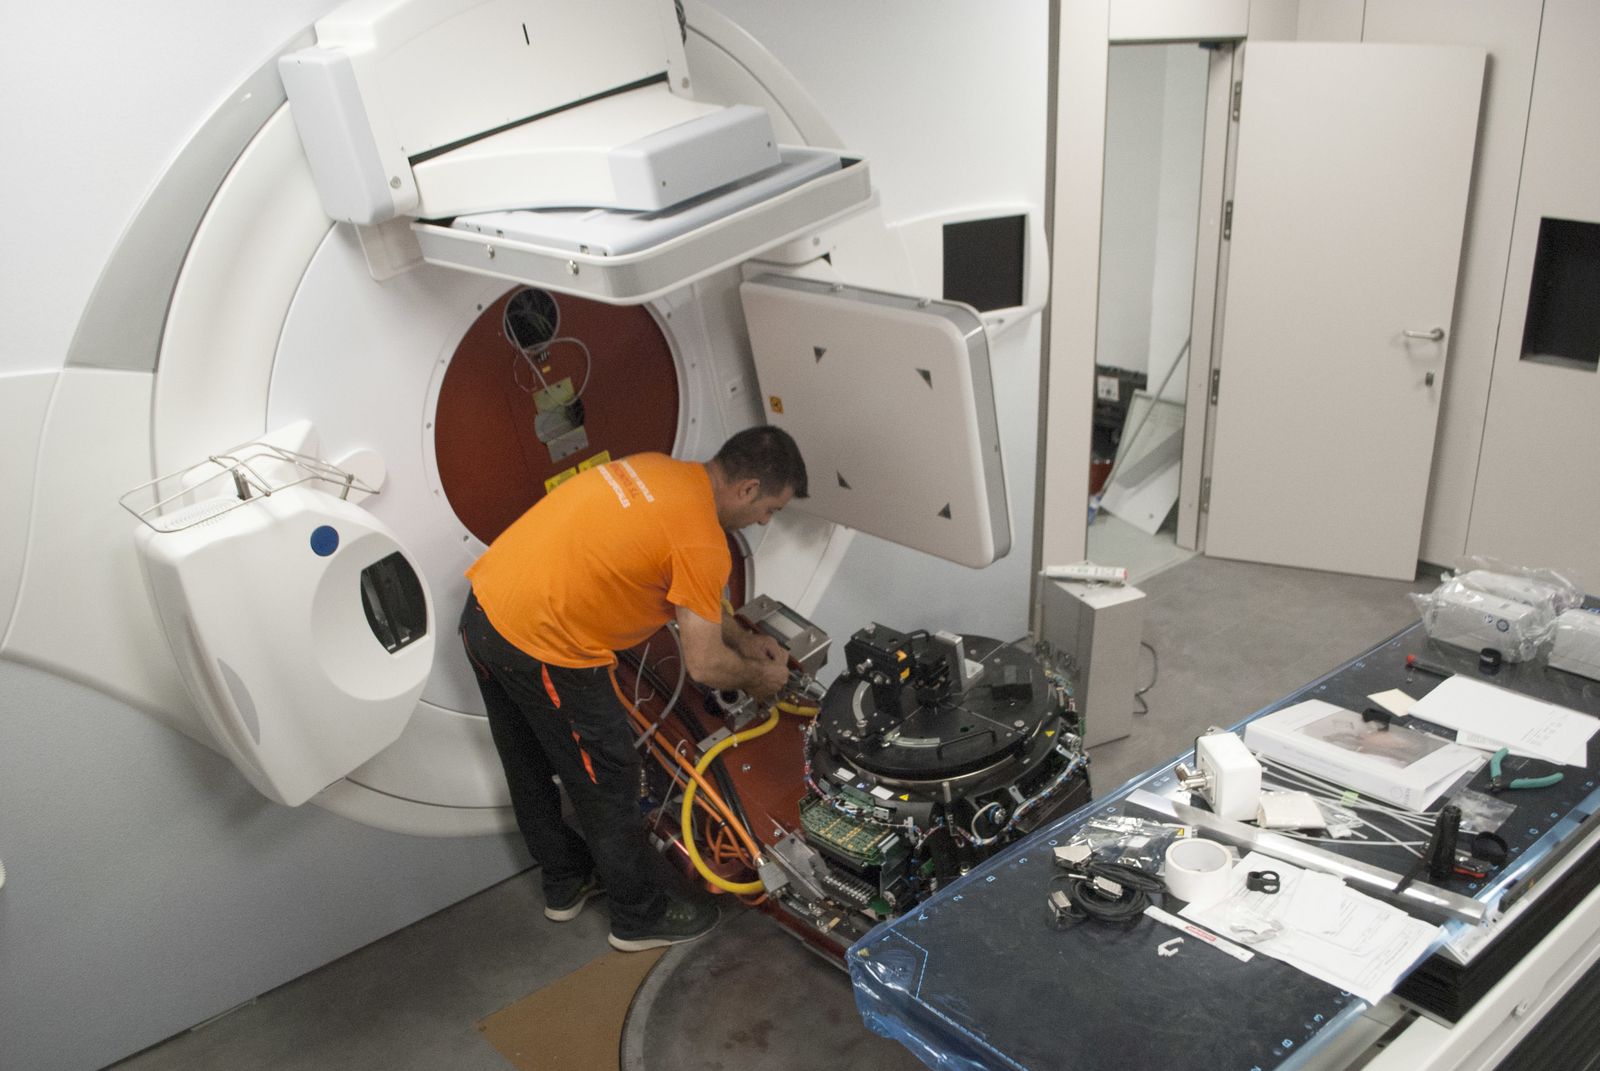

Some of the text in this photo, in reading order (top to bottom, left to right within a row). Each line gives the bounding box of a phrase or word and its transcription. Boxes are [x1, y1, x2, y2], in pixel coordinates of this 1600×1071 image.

[985, 875, 997, 883] B
[953, 894, 964, 902] 2
[917, 913, 929, 922] A
